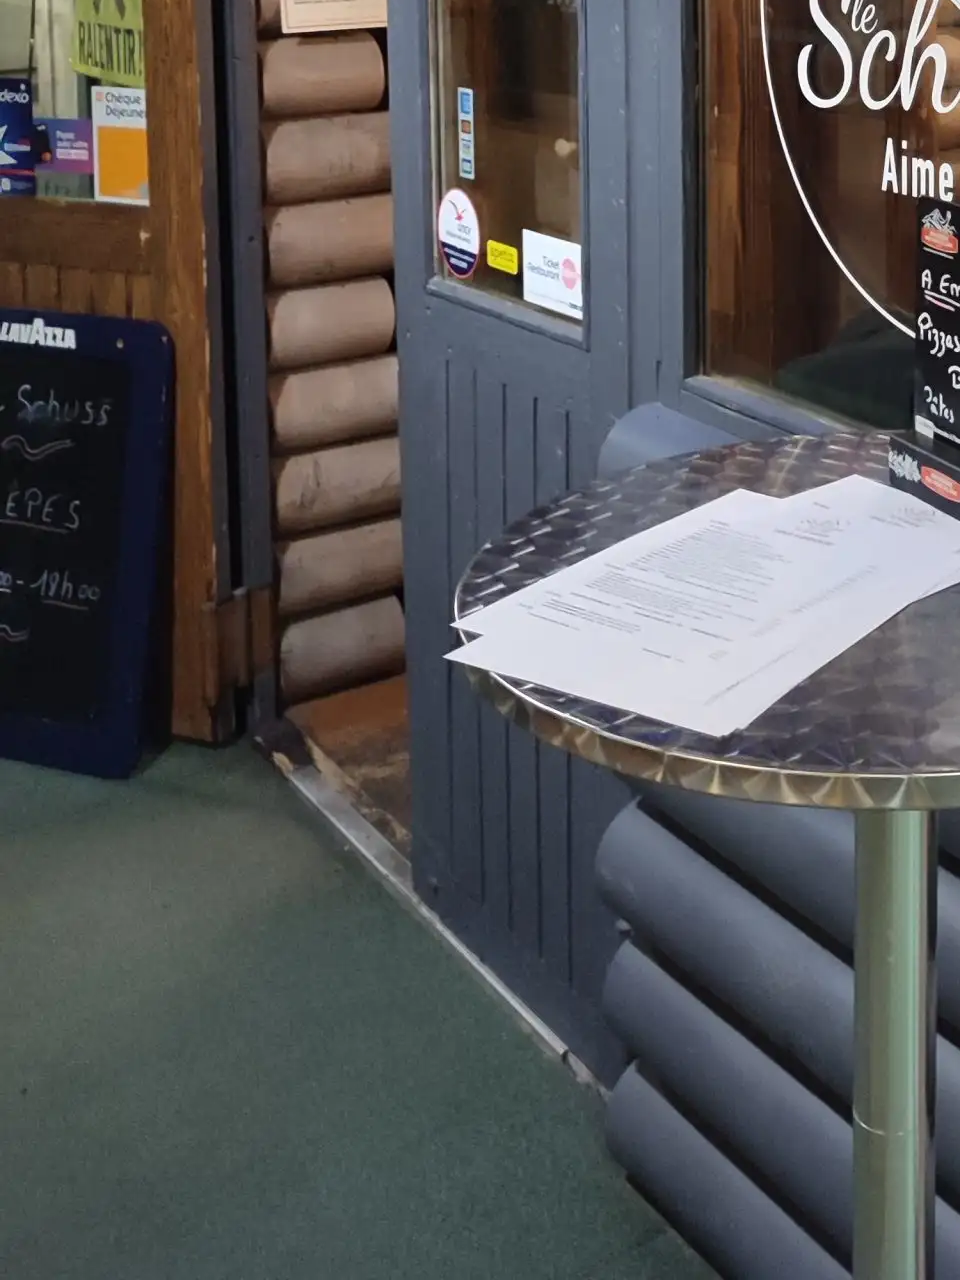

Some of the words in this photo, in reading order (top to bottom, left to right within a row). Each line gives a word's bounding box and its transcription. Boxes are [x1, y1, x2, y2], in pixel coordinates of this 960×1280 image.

[881, 137, 954, 202] Aime
[921, 269, 932, 290] A
[0, 318, 76, 349] LAVAZZA
[918, 312, 960, 358] Pizzas
[18, 384, 111, 426] Schuss
